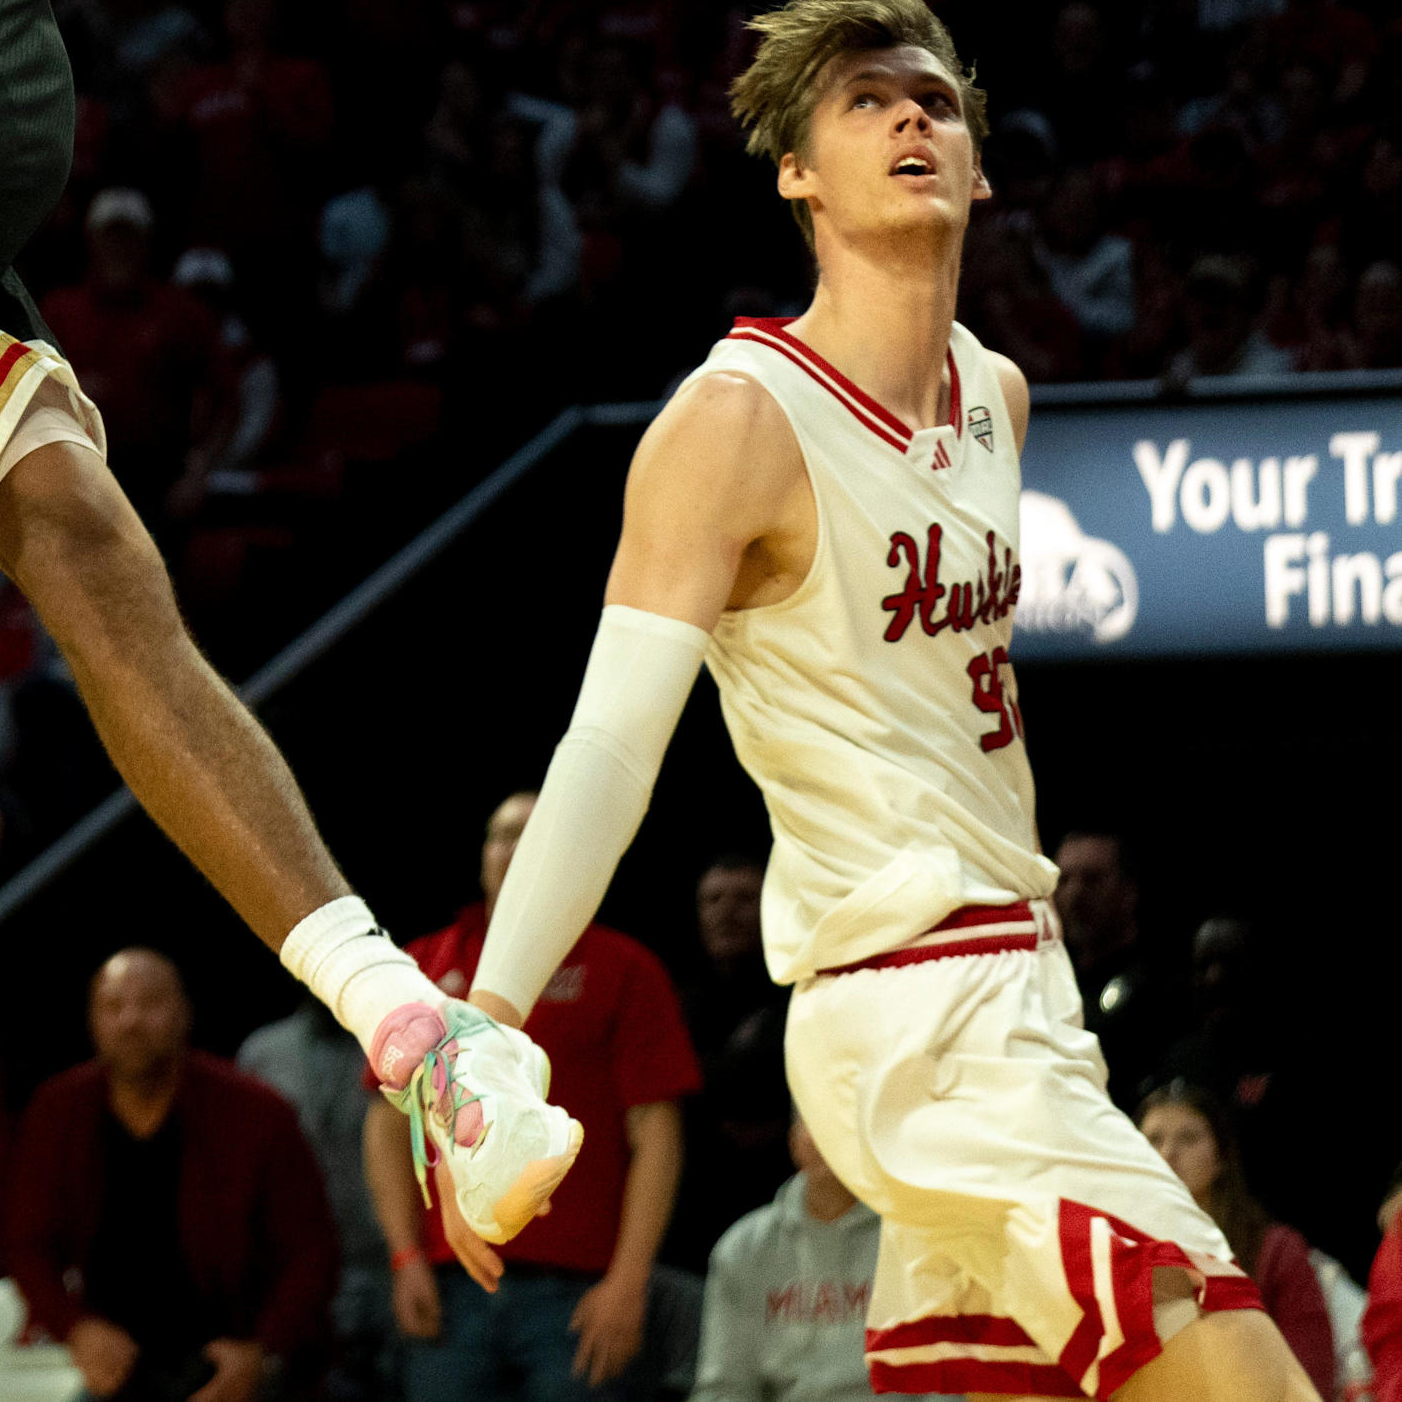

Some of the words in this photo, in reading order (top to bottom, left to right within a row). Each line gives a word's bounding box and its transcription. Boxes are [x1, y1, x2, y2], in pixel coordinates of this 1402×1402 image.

[1132, 438, 1319, 534] Your
[882, 522, 1021, 643] Huskie
[763, 1276, 874, 1326] MIAM
